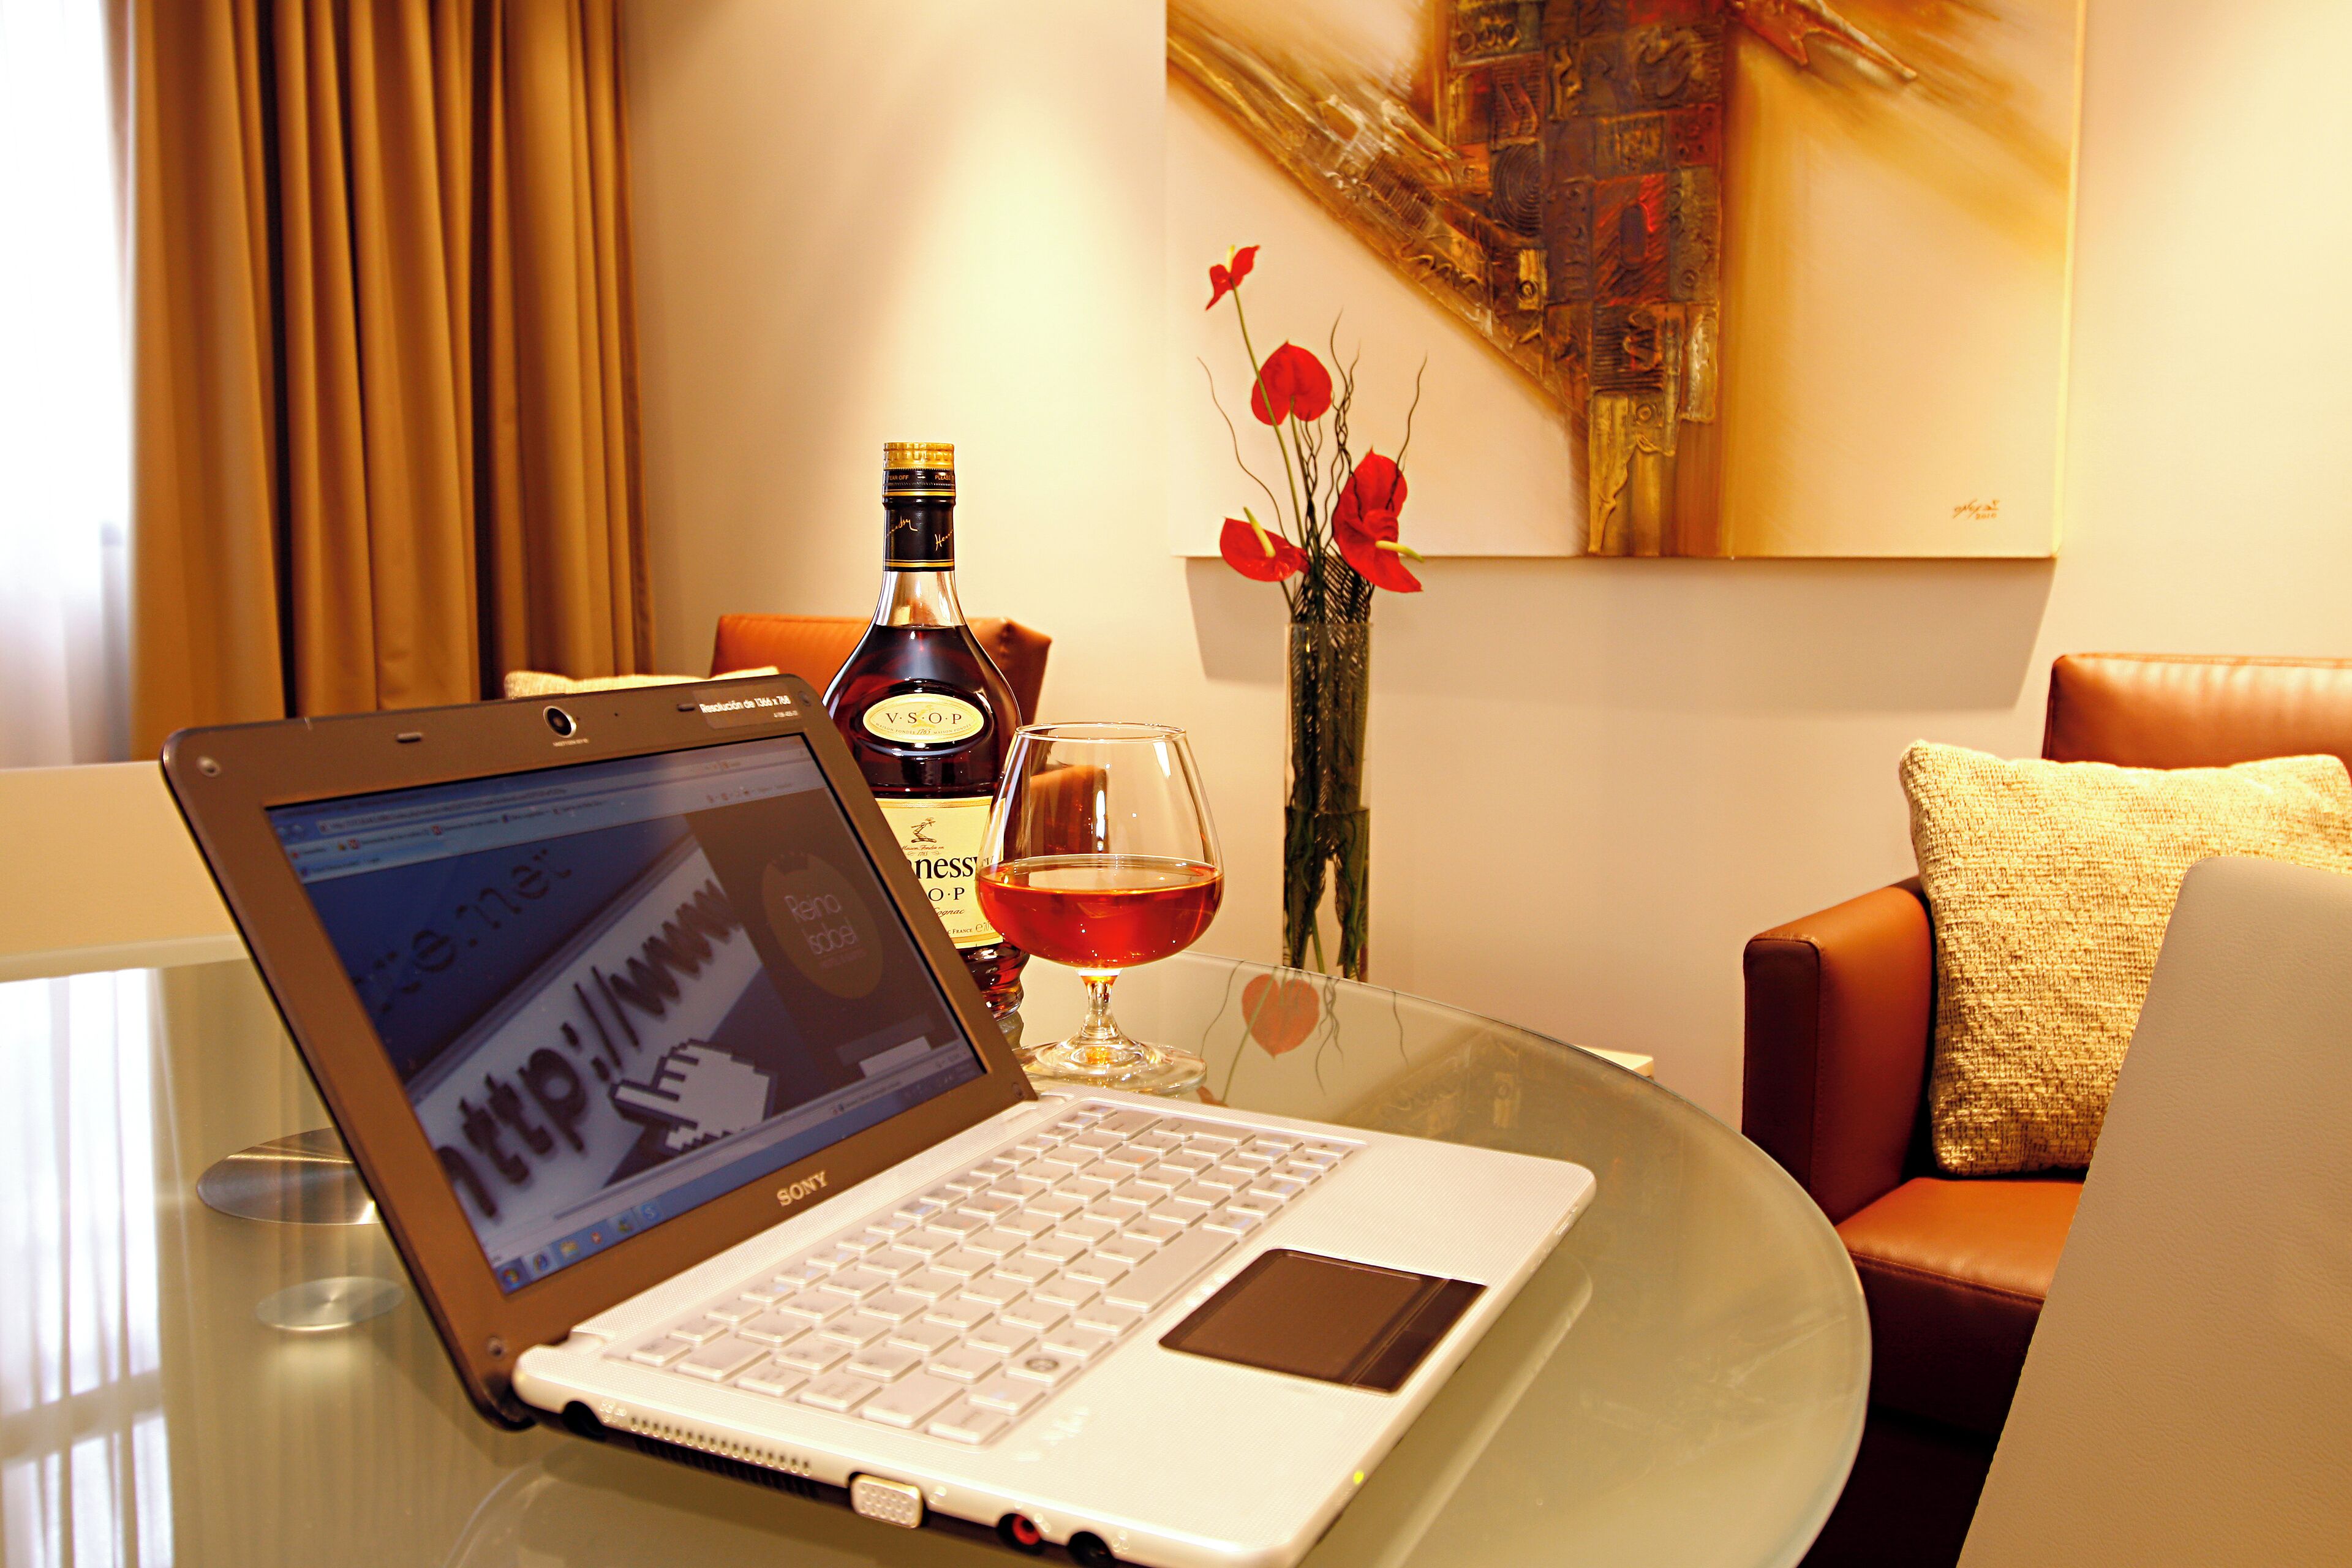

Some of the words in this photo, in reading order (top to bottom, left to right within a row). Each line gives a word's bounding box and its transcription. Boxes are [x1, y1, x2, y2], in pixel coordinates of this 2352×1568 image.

[699, 700, 744, 713] Resolución
[744, 699, 755, 709] de
[754, 697, 773, 707] 1366
[776, 695, 791, 705] 768
[876, 723, 894, 731] MAISON
[777, 1170, 827, 1207] SONY
